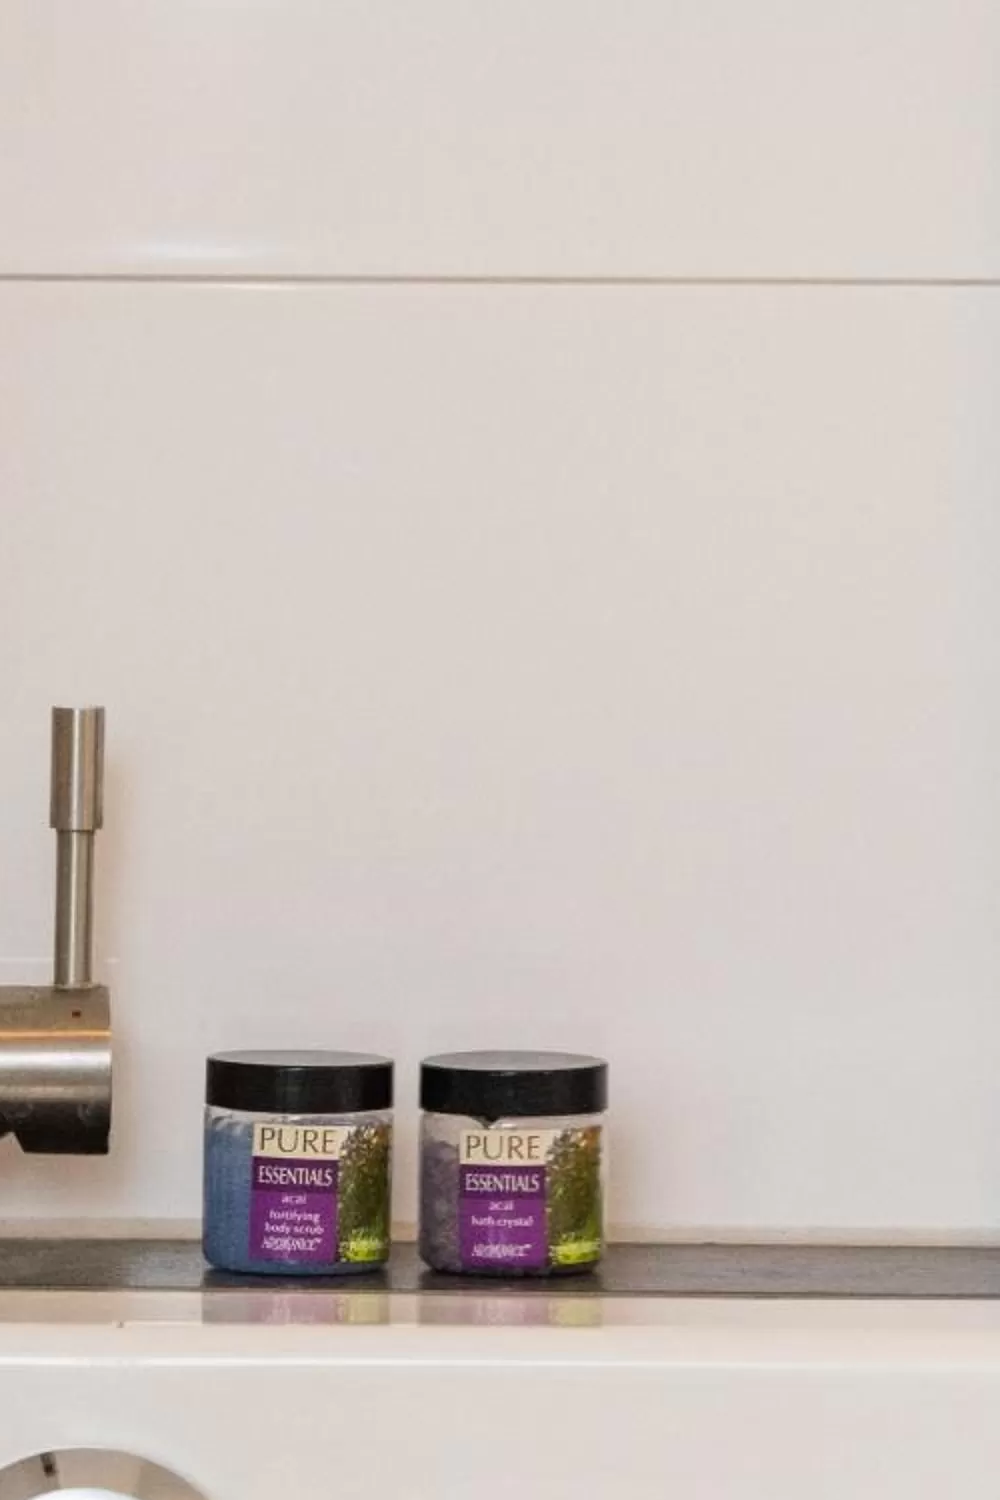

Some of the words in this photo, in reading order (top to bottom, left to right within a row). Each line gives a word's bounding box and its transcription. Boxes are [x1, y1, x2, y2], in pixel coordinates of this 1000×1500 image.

[260, 1127, 336, 1154] PURE
[466, 1135, 541, 1160] PURE
[258, 1165, 333, 1187] ESSENTIALS
[465, 1173, 540, 1193] ESSENTIALS
[264, 1221, 291, 1235] body
[293, 1223, 325, 1235] scrub
